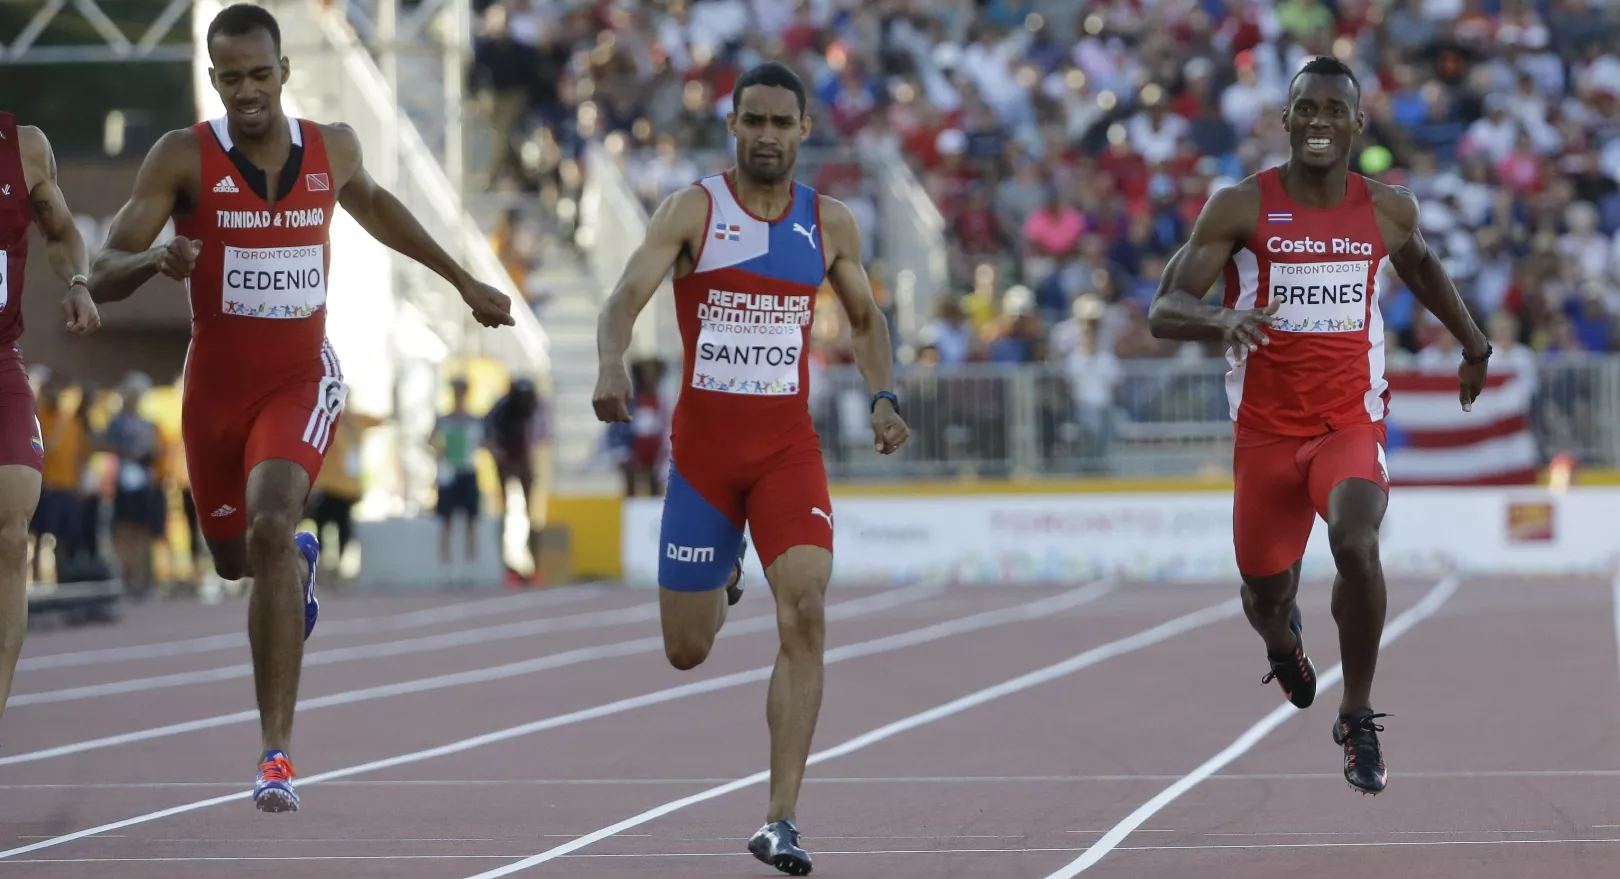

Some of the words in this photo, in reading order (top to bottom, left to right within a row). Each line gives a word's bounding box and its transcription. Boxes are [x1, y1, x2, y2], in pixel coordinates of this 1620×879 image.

[212, 185, 240, 193] adidas
[216, 210, 271, 228] TRINIDAD
[273, 212, 283, 227] &
[284, 207, 324, 228] TOBAGO
[1266, 236, 1326, 253] Costa
[1331, 238, 1373, 255] Rica
[227, 268, 320, 290] CEDENIO
[707, 288, 810, 312] REPUBLICA
[1273, 283, 1363, 305] BRENES
[700, 342, 798, 366] SANTOS
[667, 542, 714, 562] DOM
